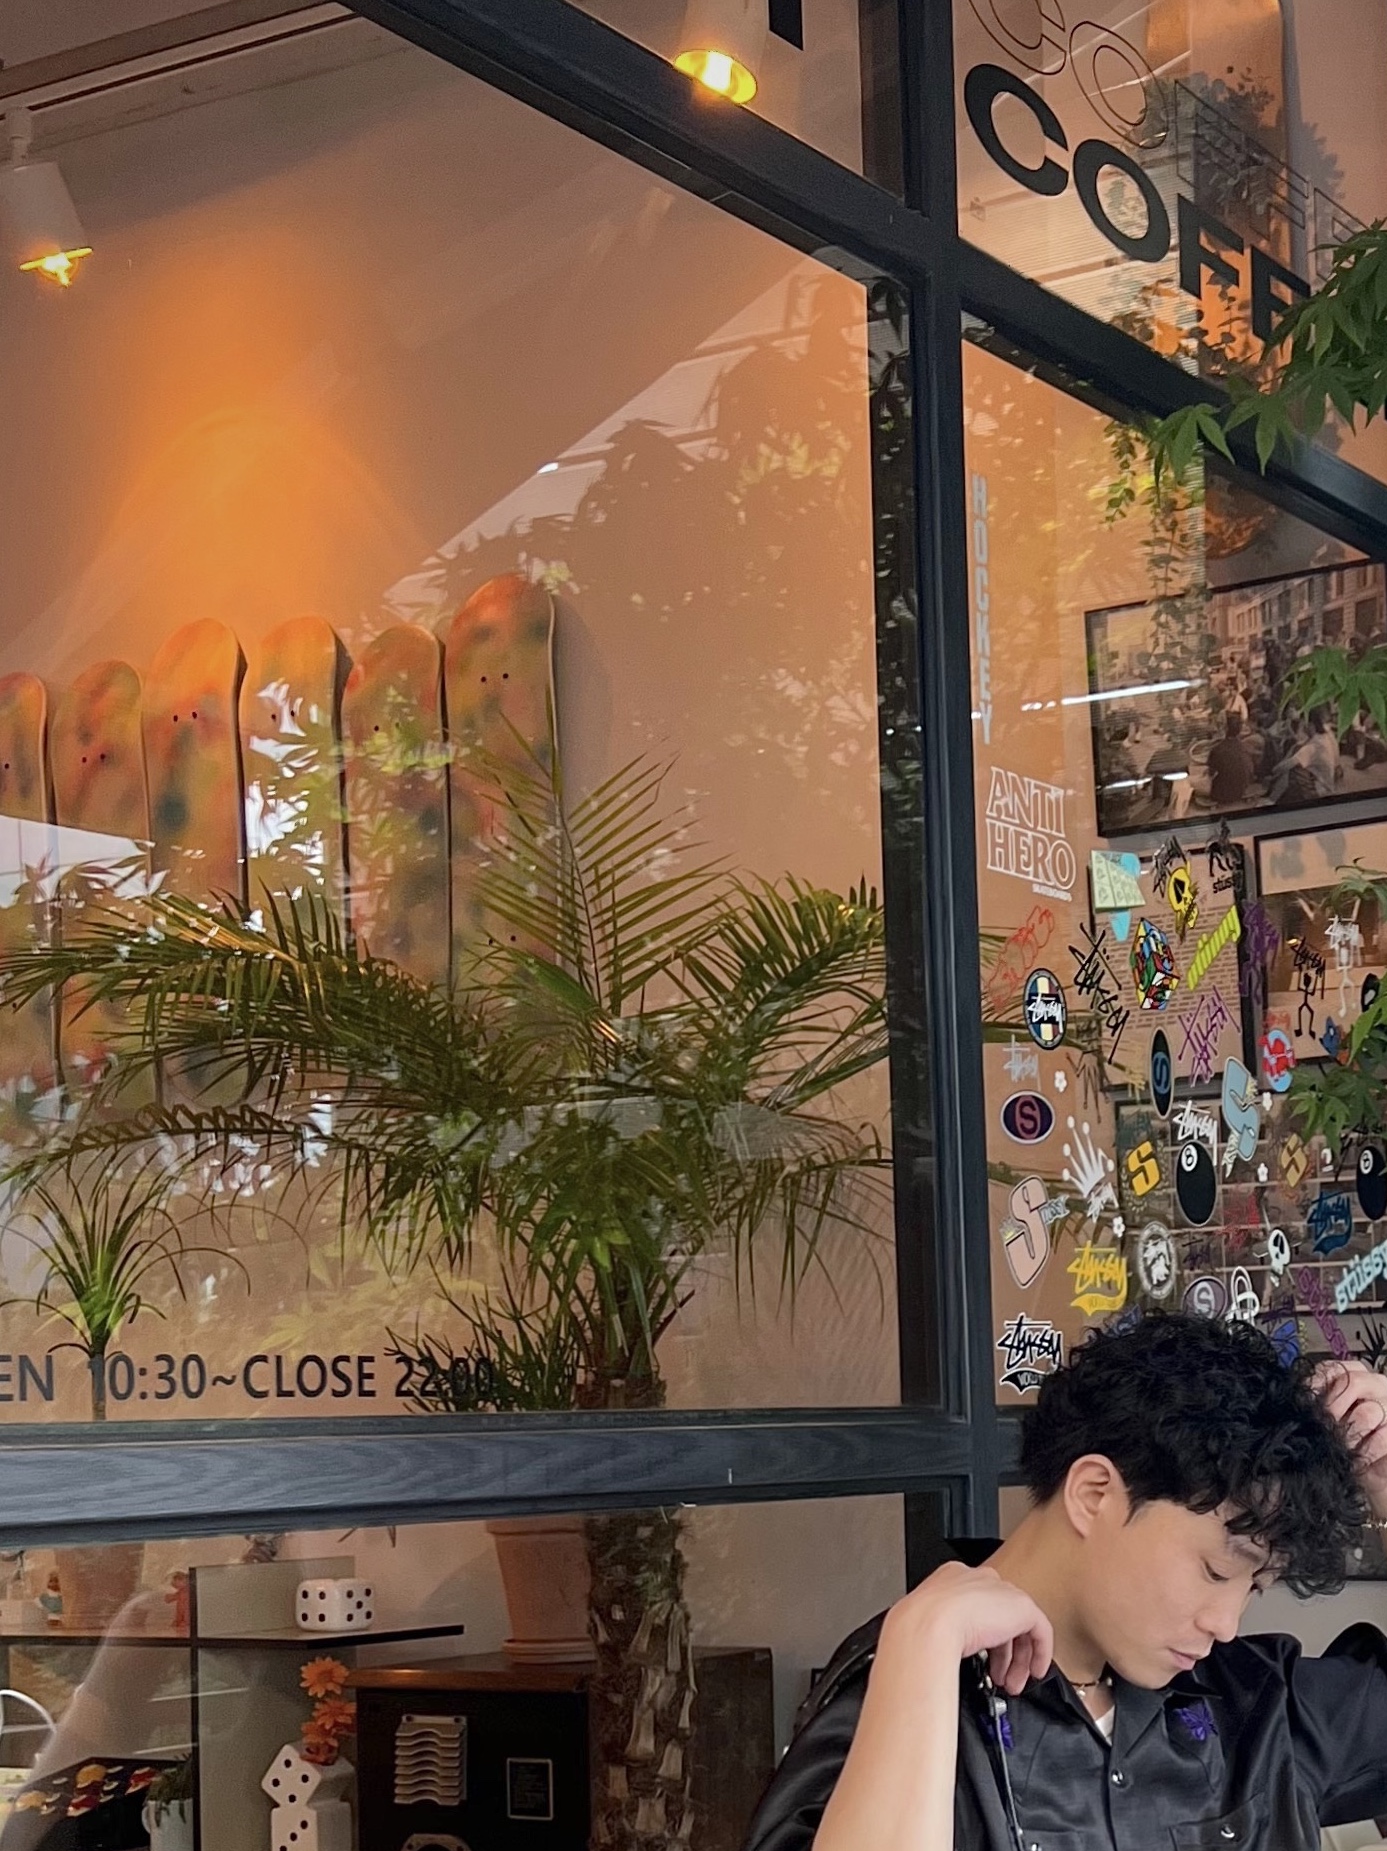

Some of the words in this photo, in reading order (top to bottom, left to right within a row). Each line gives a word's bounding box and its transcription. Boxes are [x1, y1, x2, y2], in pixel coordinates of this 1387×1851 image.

[971, 474, 993, 745] HOCKEY
[985, 765, 1066, 838] ANTI
[985, 817, 1077, 891] HERO
